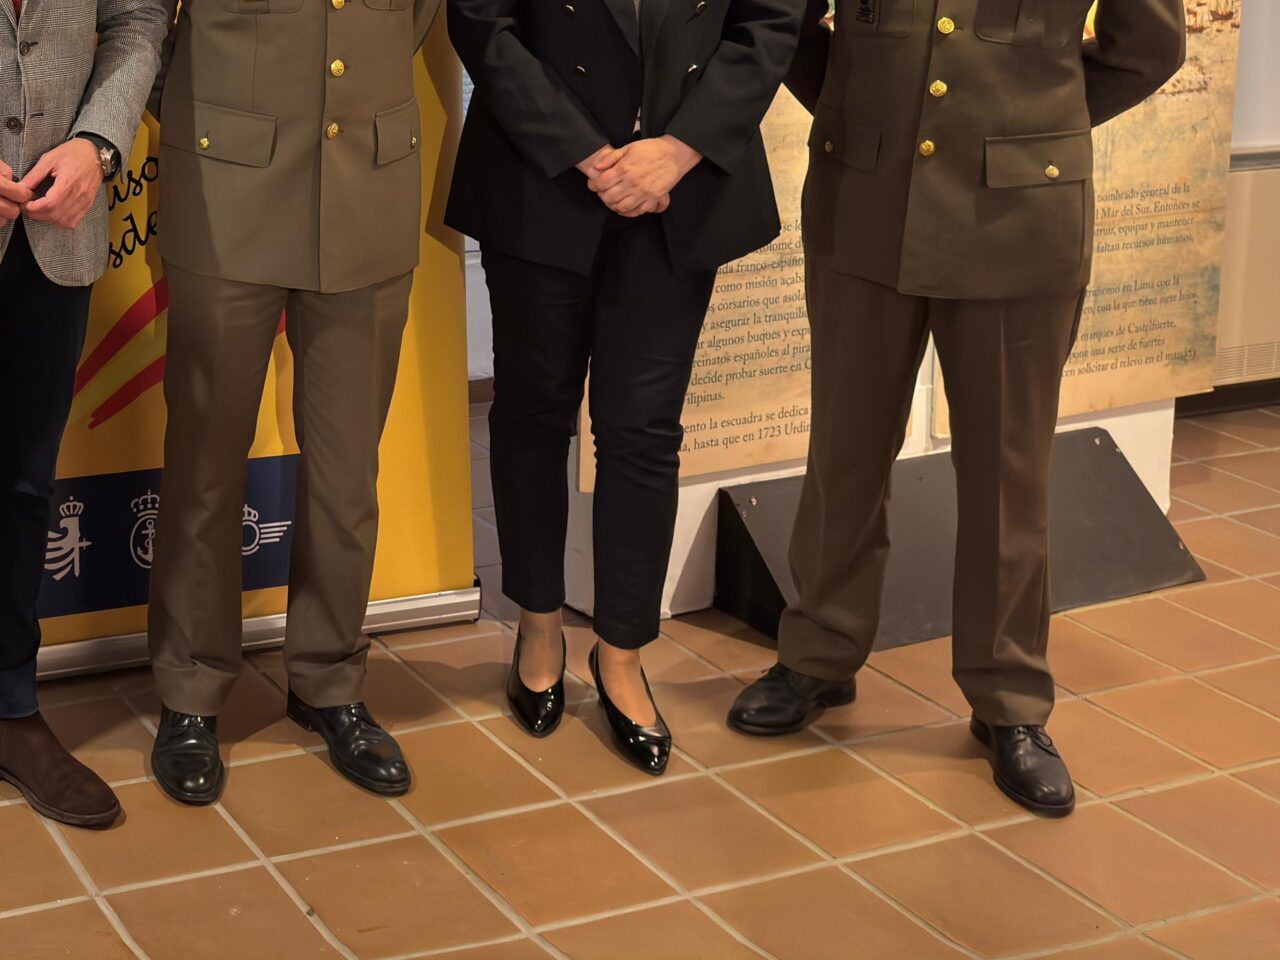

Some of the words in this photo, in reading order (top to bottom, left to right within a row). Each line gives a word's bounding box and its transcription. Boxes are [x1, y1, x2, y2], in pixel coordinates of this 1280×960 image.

[1140, 184, 1169, 200] general
[1171, 182, 1181, 194] de
[1183, 182, 1190, 193] la
[1101, 207, 1119, 220] Mar
[1121, 205, 1133, 217] del
[1150, 222, 1156, 232] y
[736, 256, 804, 273] franco-españo
[715, 283, 742, 294] como
[745, 276, 777, 290] misión
[780, 271, 805, 286] acab
[1085, 286, 1120, 298] trimonio
[1122, 283, 1133, 293] en
[1173, 274, 1180, 286] la
[717, 298, 760, 311] corsarios
[762, 296, 779, 309] que
[782, 290, 806, 304] asola
[1113, 300, 1121, 311] la
[710, 317, 750, 331] asegurar
[753, 313, 761, 324] la
[764, 306, 808, 324] tranquili
[707, 336, 744, 351] algunos
[747, 331, 781, 346] buques
[783, 328, 790, 340] y
[692, 356, 730, 368] reinatos
[734, 348, 779, 365] españoles
[782, 345, 789, 356] al
[792, 344, 811, 357] pira
[1111, 358, 1118, 370] el
[1156, 351, 1163, 362] el
[691, 372, 722, 386] decide
[725, 367, 756, 385] probar
[759, 364, 787, 377] suerte
[790, 363, 802, 372] en
[685, 391, 725, 407] ilipinas.
[684, 423, 707, 434] ento
[709, 417, 718, 430] la
[720, 412, 762, 428] escuadra
[765, 412, 775, 421] se
[778, 404, 809, 419] dedica
[694, 438, 719, 451] hasta
[722, 436, 740, 448] que
[743, 433, 754, 443] en
[758, 426, 782, 440] 1723
